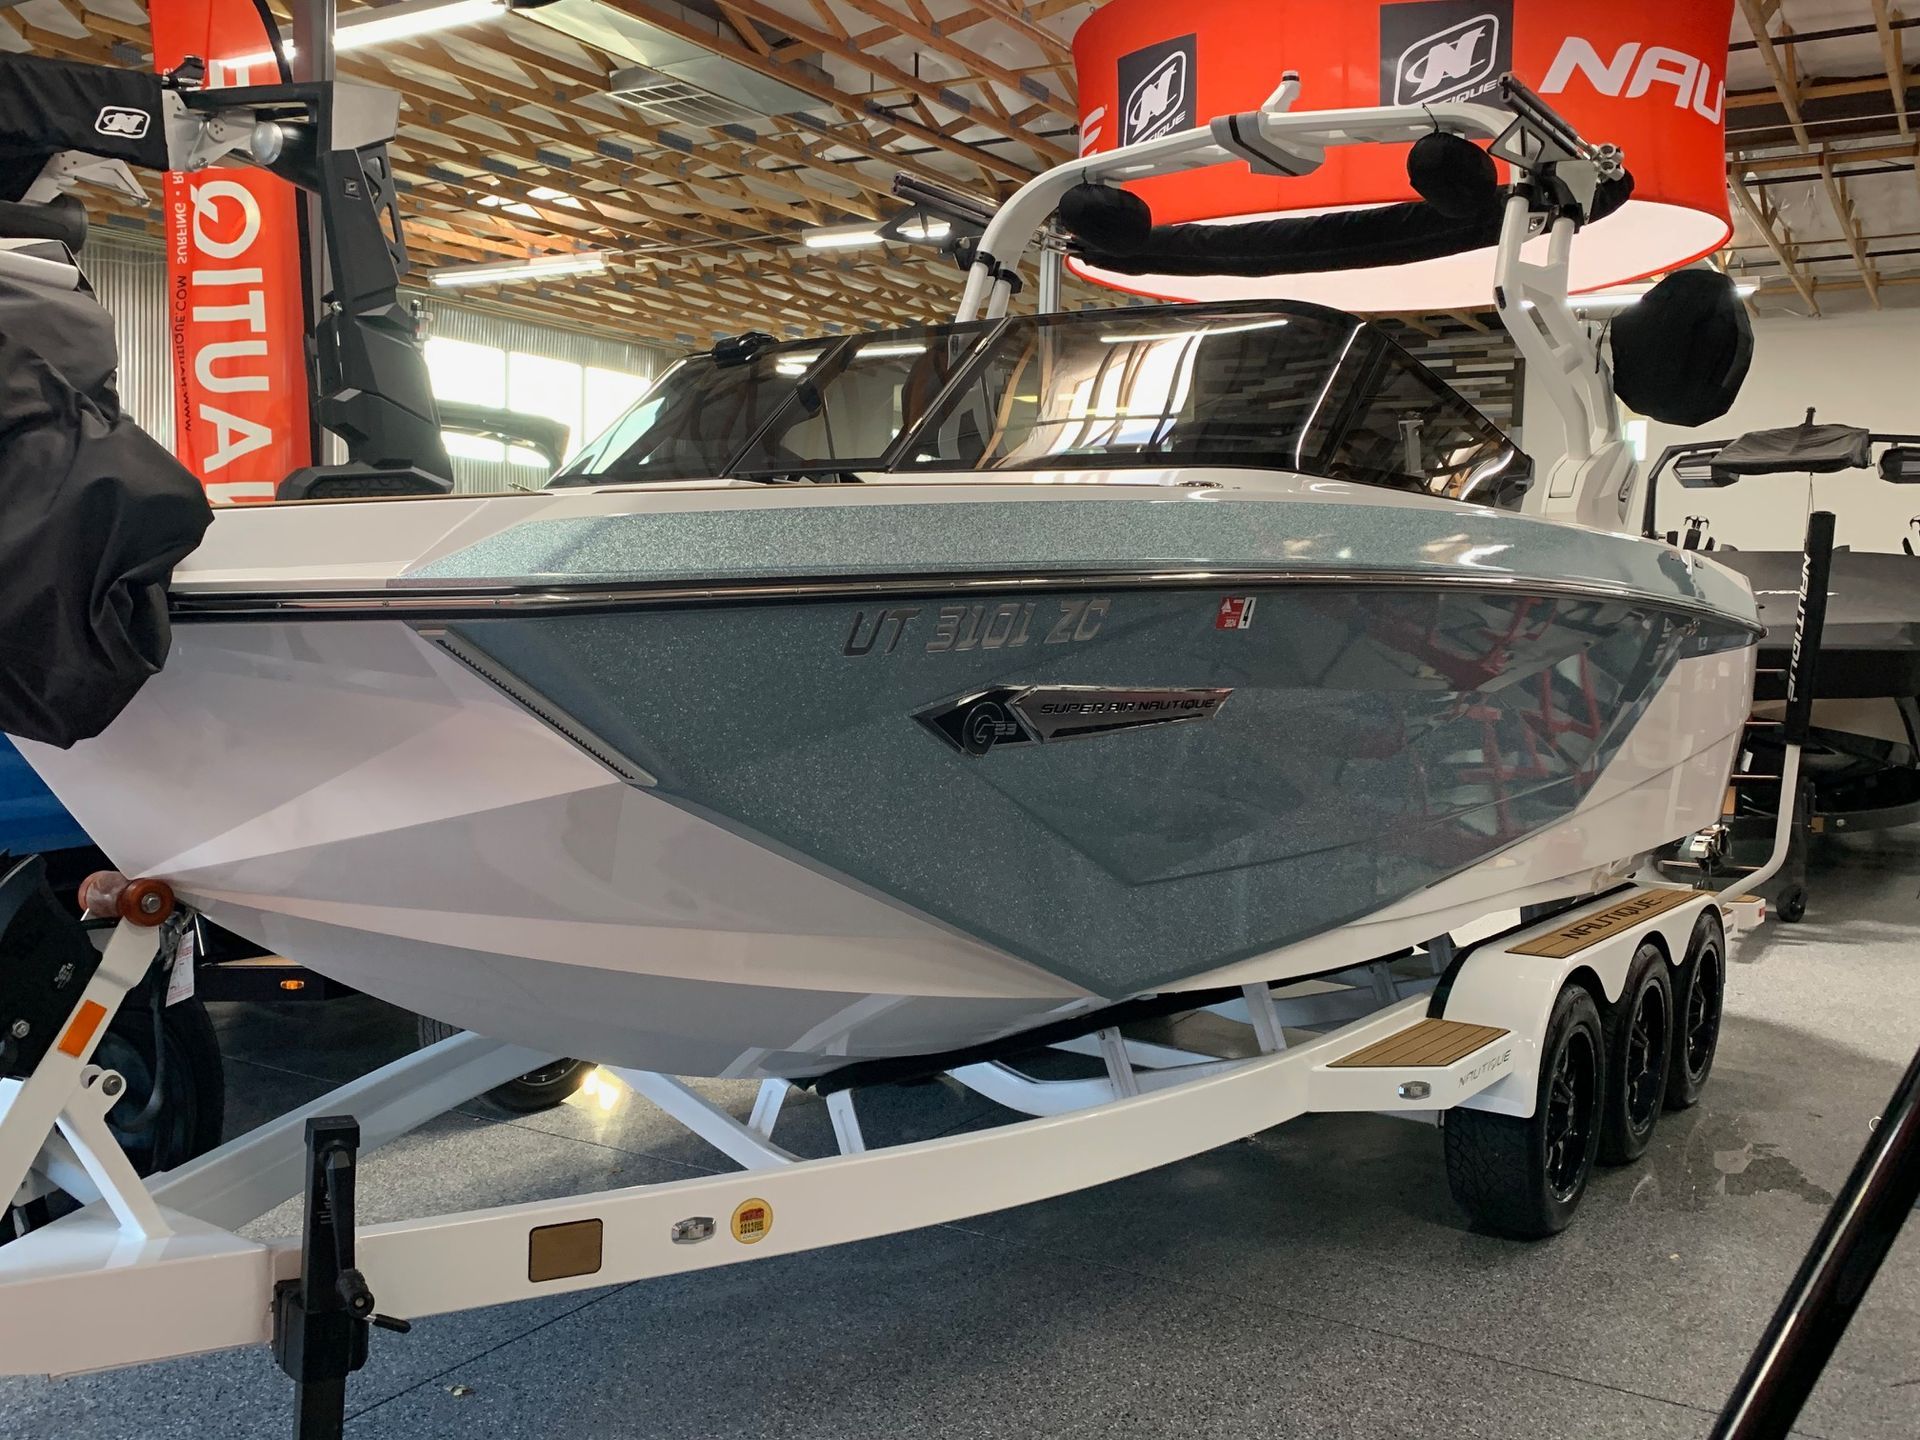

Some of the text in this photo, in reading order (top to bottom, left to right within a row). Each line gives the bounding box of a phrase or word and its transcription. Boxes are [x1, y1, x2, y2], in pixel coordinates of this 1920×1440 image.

[1538, 36, 1726, 125] NAU
[843, 599, 1112, 658] UT 3101 ZC
[1040, 698, 1217, 715] SUPER AIR NAUTIQUE
[1560, 897, 1663, 940] NAUTIQUE
[1458, 1048, 1512, 1090] NAUTIQUE
